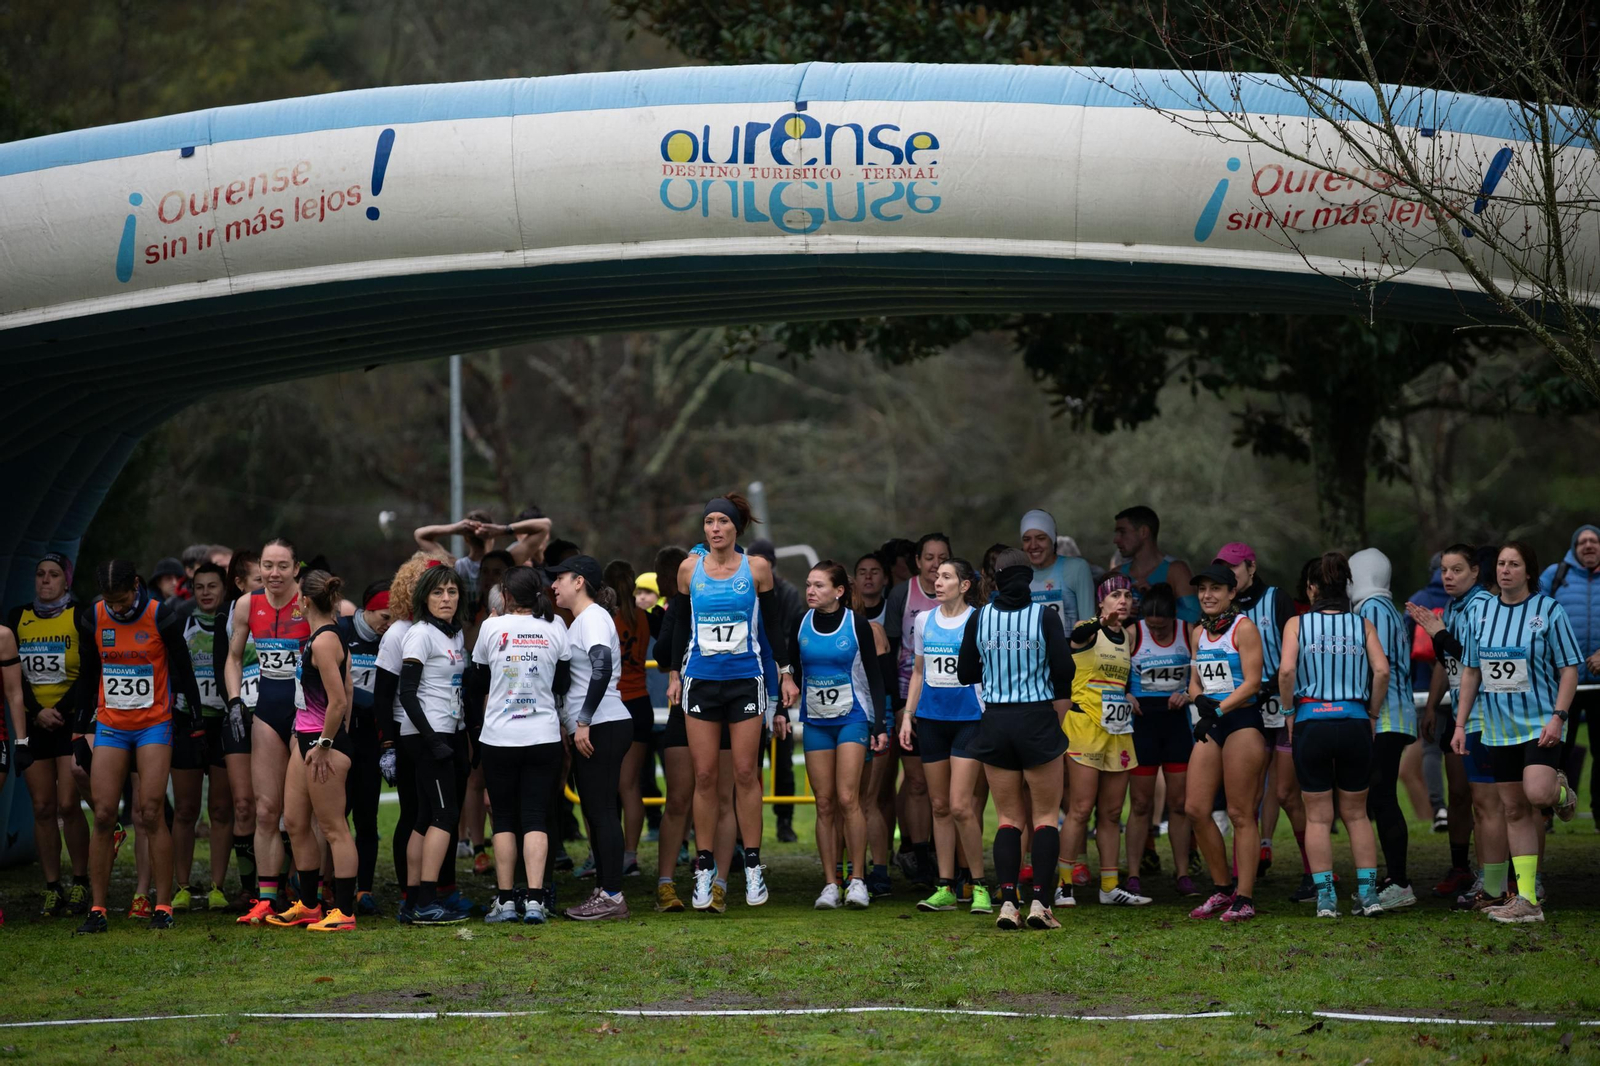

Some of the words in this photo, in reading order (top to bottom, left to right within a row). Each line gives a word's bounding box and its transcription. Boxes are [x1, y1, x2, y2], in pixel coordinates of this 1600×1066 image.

[660, 113, 940, 166] ourense
[662, 164, 741, 178] DESTINO
[748, 166, 842, 179] TURISTICO
[861, 167, 939, 180] TERMAL
[1226, 205, 1273, 231] sin
[1282, 204, 1305, 228] ir
[1312, 199, 1379, 227] más
[145, 236, 187, 264] sin
[198, 226, 215, 250] ir
[225, 206, 285, 242] más
[294, 185, 362, 223] lejos
[711, 625, 735, 643] 17
[22, 655, 60, 672] 183
[109, 650, 148, 660] OVIEDO
[260, 651, 297, 669] 234
[506, 651, 538, 662] amobla
[103, 667, 136, 675] RIBADAVIA
[933, 656, 957, 675] 18
[1147, 666, 1185, 682] 145
[1489, 661, 1516, 680] 39
[107, 677, 150, 696] 230
[815, 688, 840, 706] 19
[1105, 703, 1132, 722] 209
